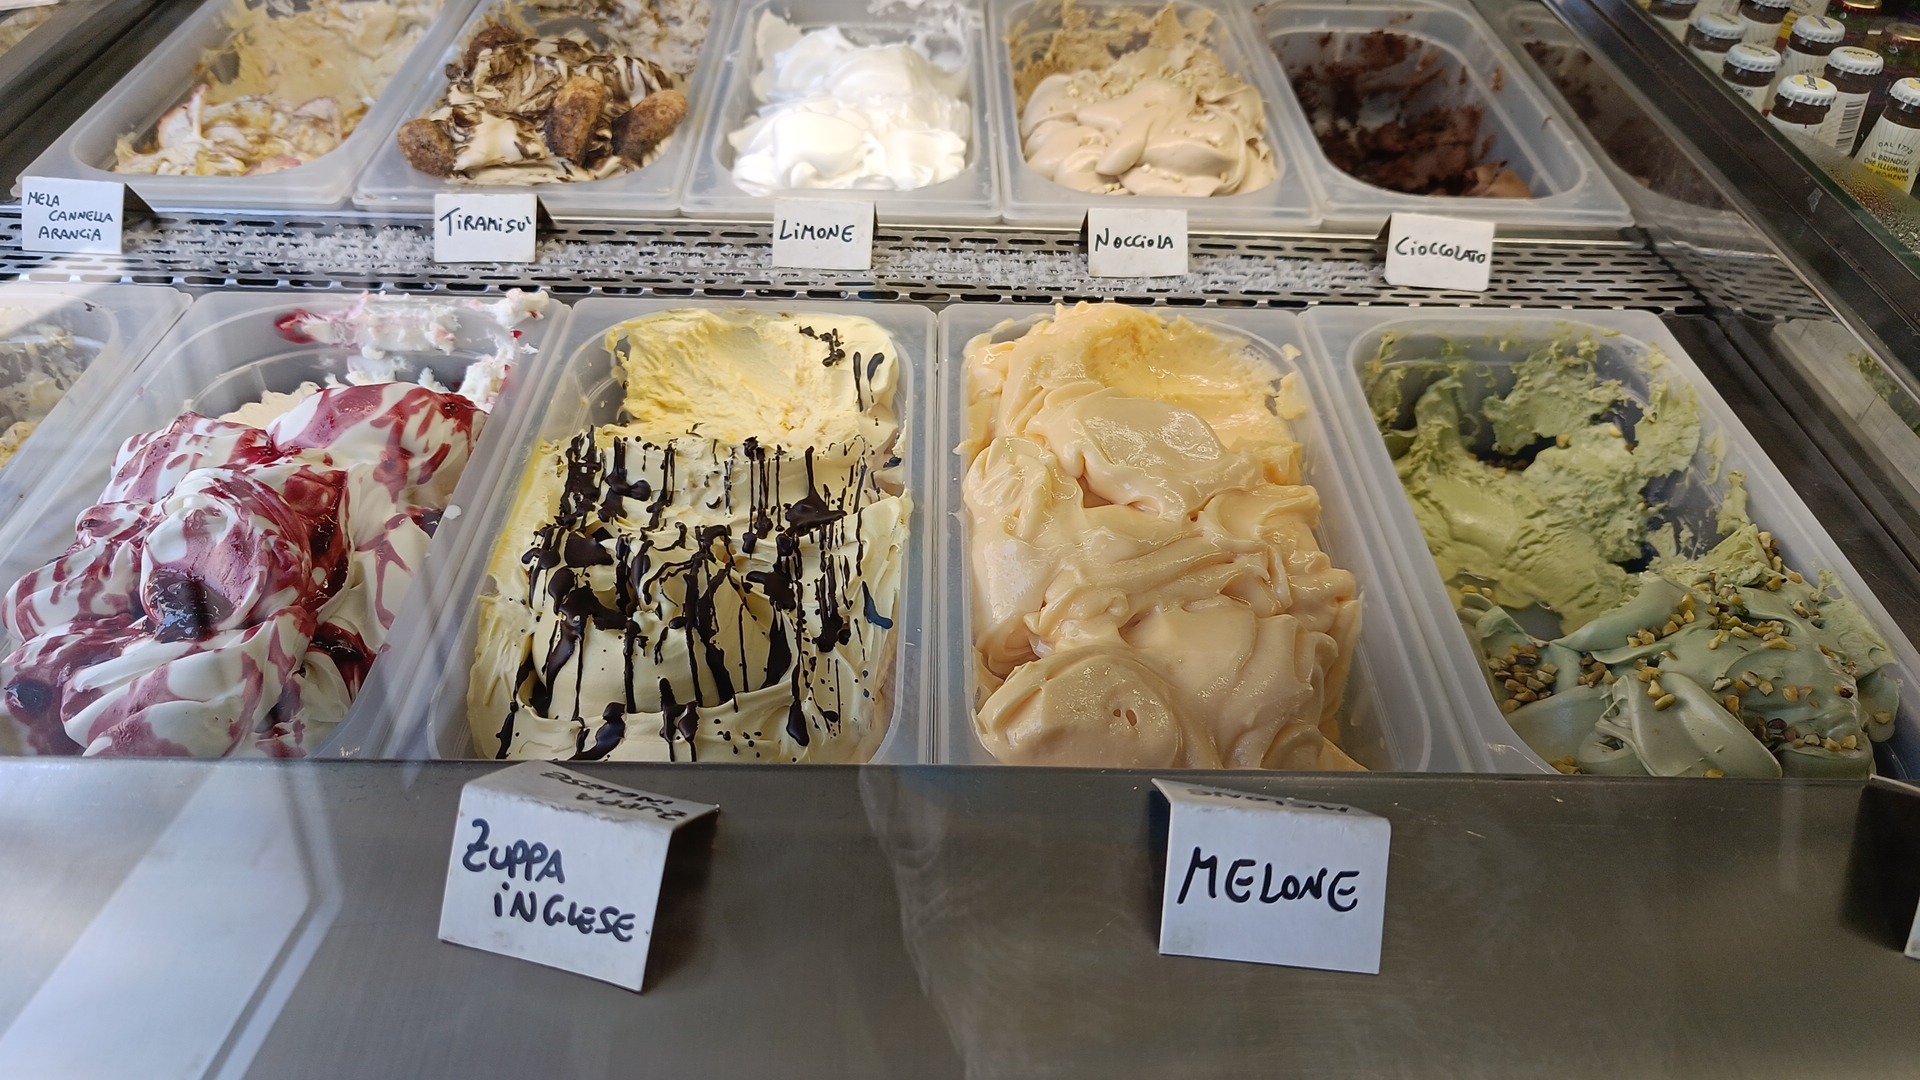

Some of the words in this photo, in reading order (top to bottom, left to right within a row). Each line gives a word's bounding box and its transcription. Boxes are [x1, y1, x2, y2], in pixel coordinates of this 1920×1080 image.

[1876, 161, 1909, 174] ILLUMINA
[1877, 153, 1910, 167] BRINDISI
[27, 191, 60, 207] MELA
[48, 209, 114, 223] CANNELLA
[461, 817, 566, 884] ZUPPA
[1176, 845, 1361, 913] MELONE
